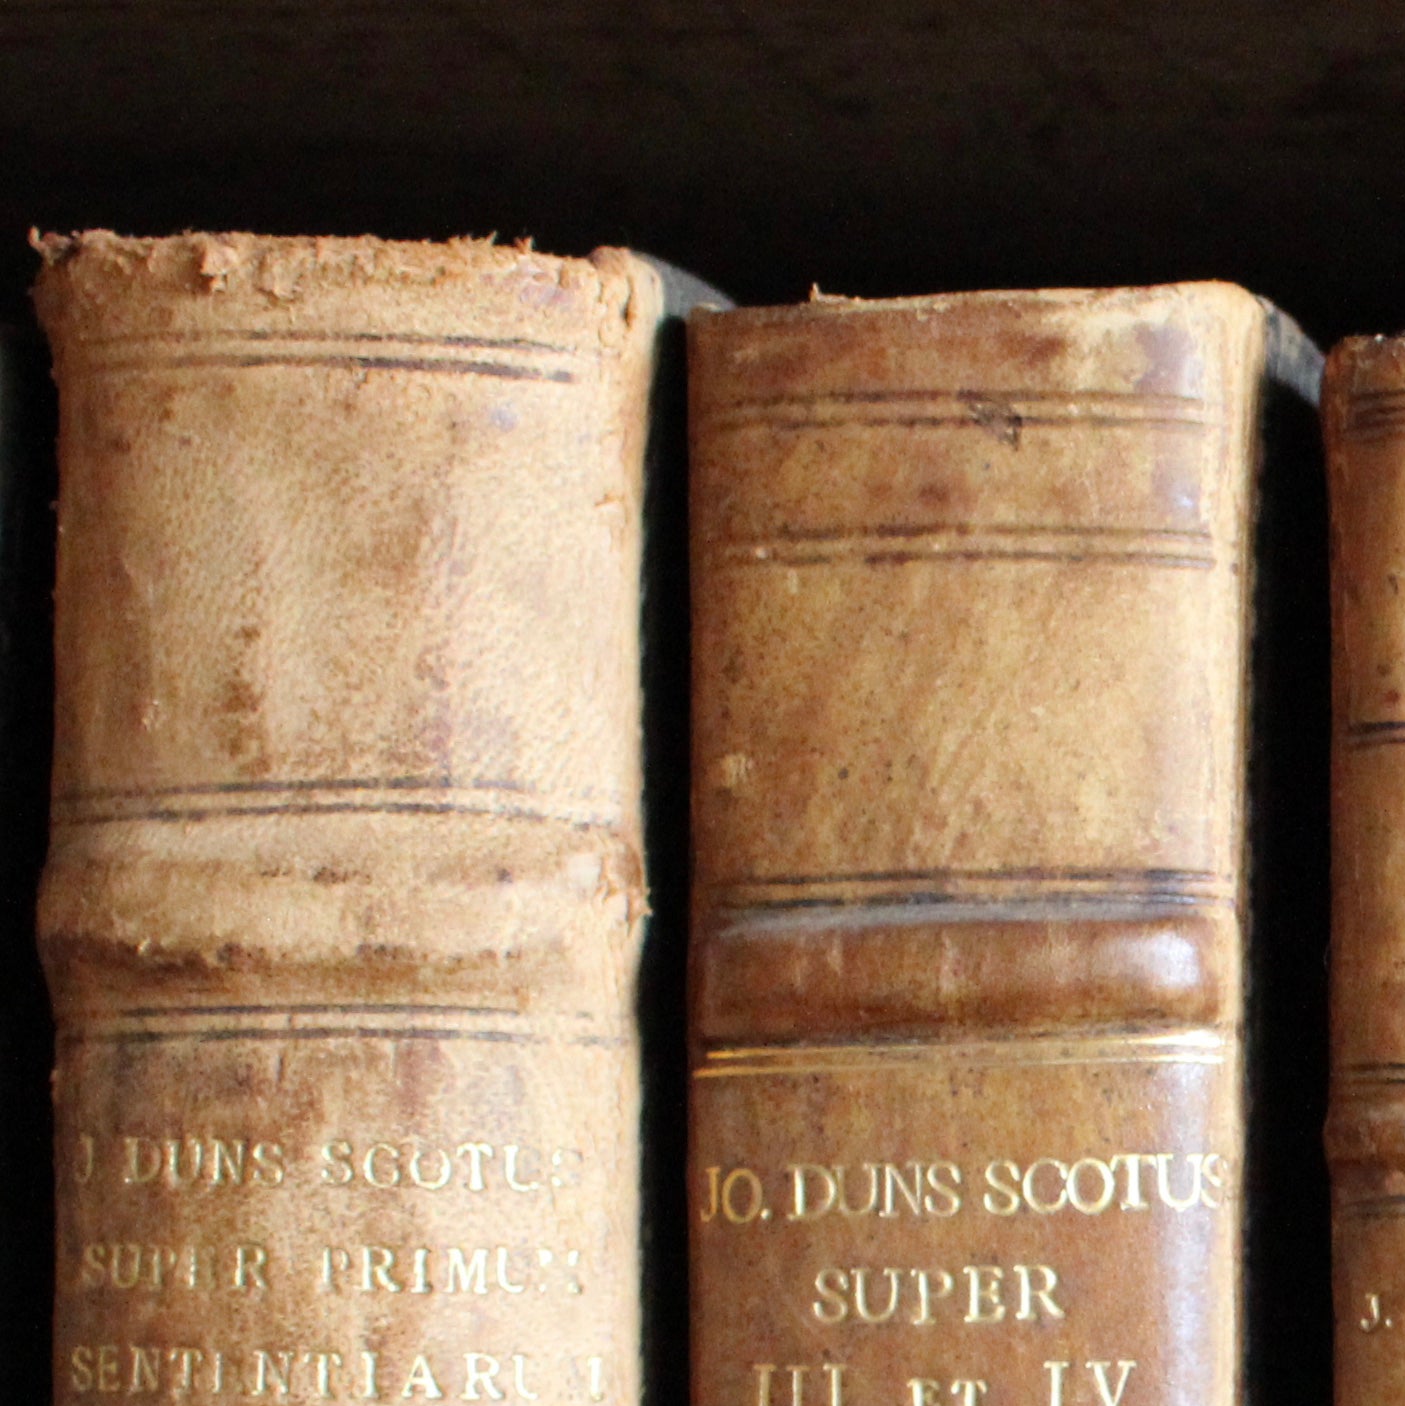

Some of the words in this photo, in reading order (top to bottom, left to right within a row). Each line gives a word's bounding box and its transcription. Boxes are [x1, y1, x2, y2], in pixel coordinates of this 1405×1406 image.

[123, 1136, 286, 1188] DUNS
[701, 1167, 772, 1224] JO.
[788, 1160, 962, 1221] DUNS
[984, 1153, 1229, 1215] SCOTUS
[813, 1264, 1066, 1326] SUPER
[1360, 1293, 1394, 1333] J.
